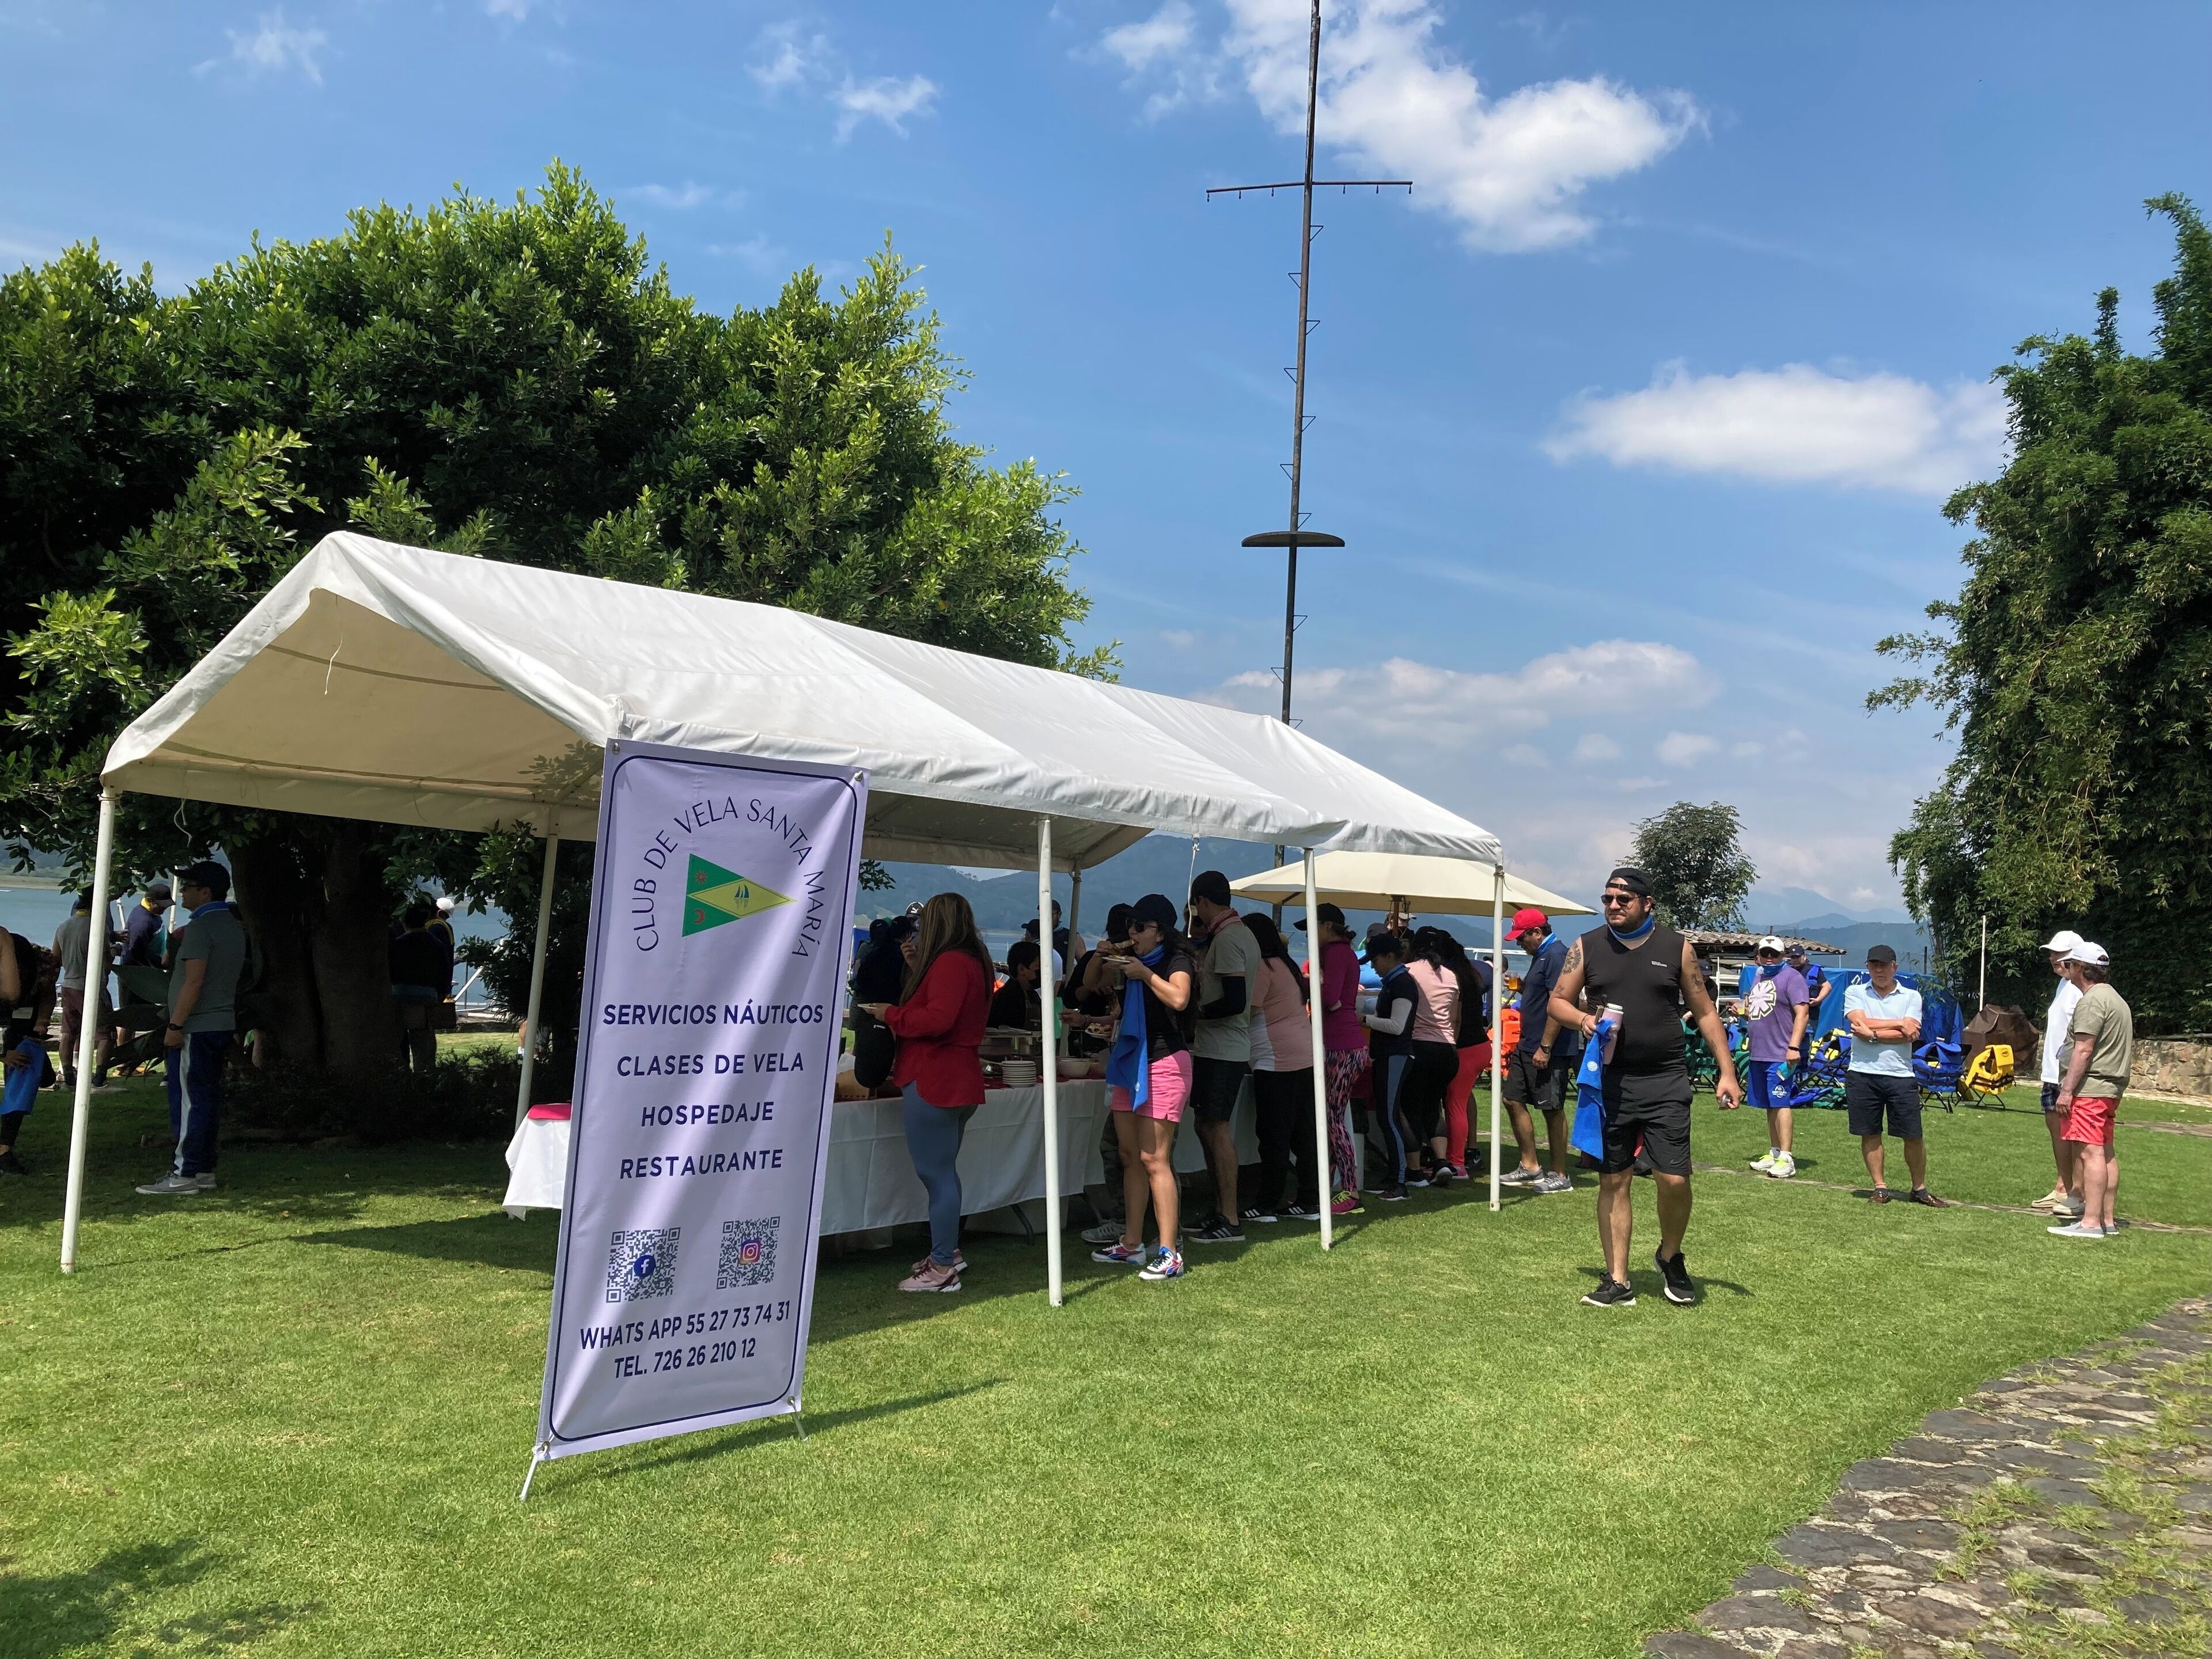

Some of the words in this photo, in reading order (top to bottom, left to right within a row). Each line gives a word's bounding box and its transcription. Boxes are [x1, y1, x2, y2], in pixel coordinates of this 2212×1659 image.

[673, 796, 738, 834] VELA
[747, 799, 812, 866] SANTA
[643, 830, 679, 870] DE
[631, 878, 659, 952] CLUB
[791, 870, 825, 957] MARÍA
[603, 1004, 717, 1025] SERVICIOS
[724, 998, 824, 1025] NÁUTICOS
[617, 1054, 704, 1077] CLASES
[715, 1054, 745, 1074] DE
[753, 1052, 804, 1073] VELA
[641, 1101, 774, 1127] HOSPEDAJE
[620, 1149, 783, 1179] RESTAURANTE
[580, 1321, 645, 1350] WHATS
[647, 1316, 682, 1340] APP
[685, 1312, 705, 1335] 55
[709, 1309, 729, 1332] 27
[732, 1306, 751, 1328] 73
[754, 1303, 772, 1325] 74
[776, 1300, 790, 1321] 31
[614, 1355, 647, 1378] TEL.
[653, 1349, 683, 1373] 726
[686, 1345, 706, 1368] 26
[710, 1340, 736, 1363] 210
[741, 1337, 756, 1358] 12
